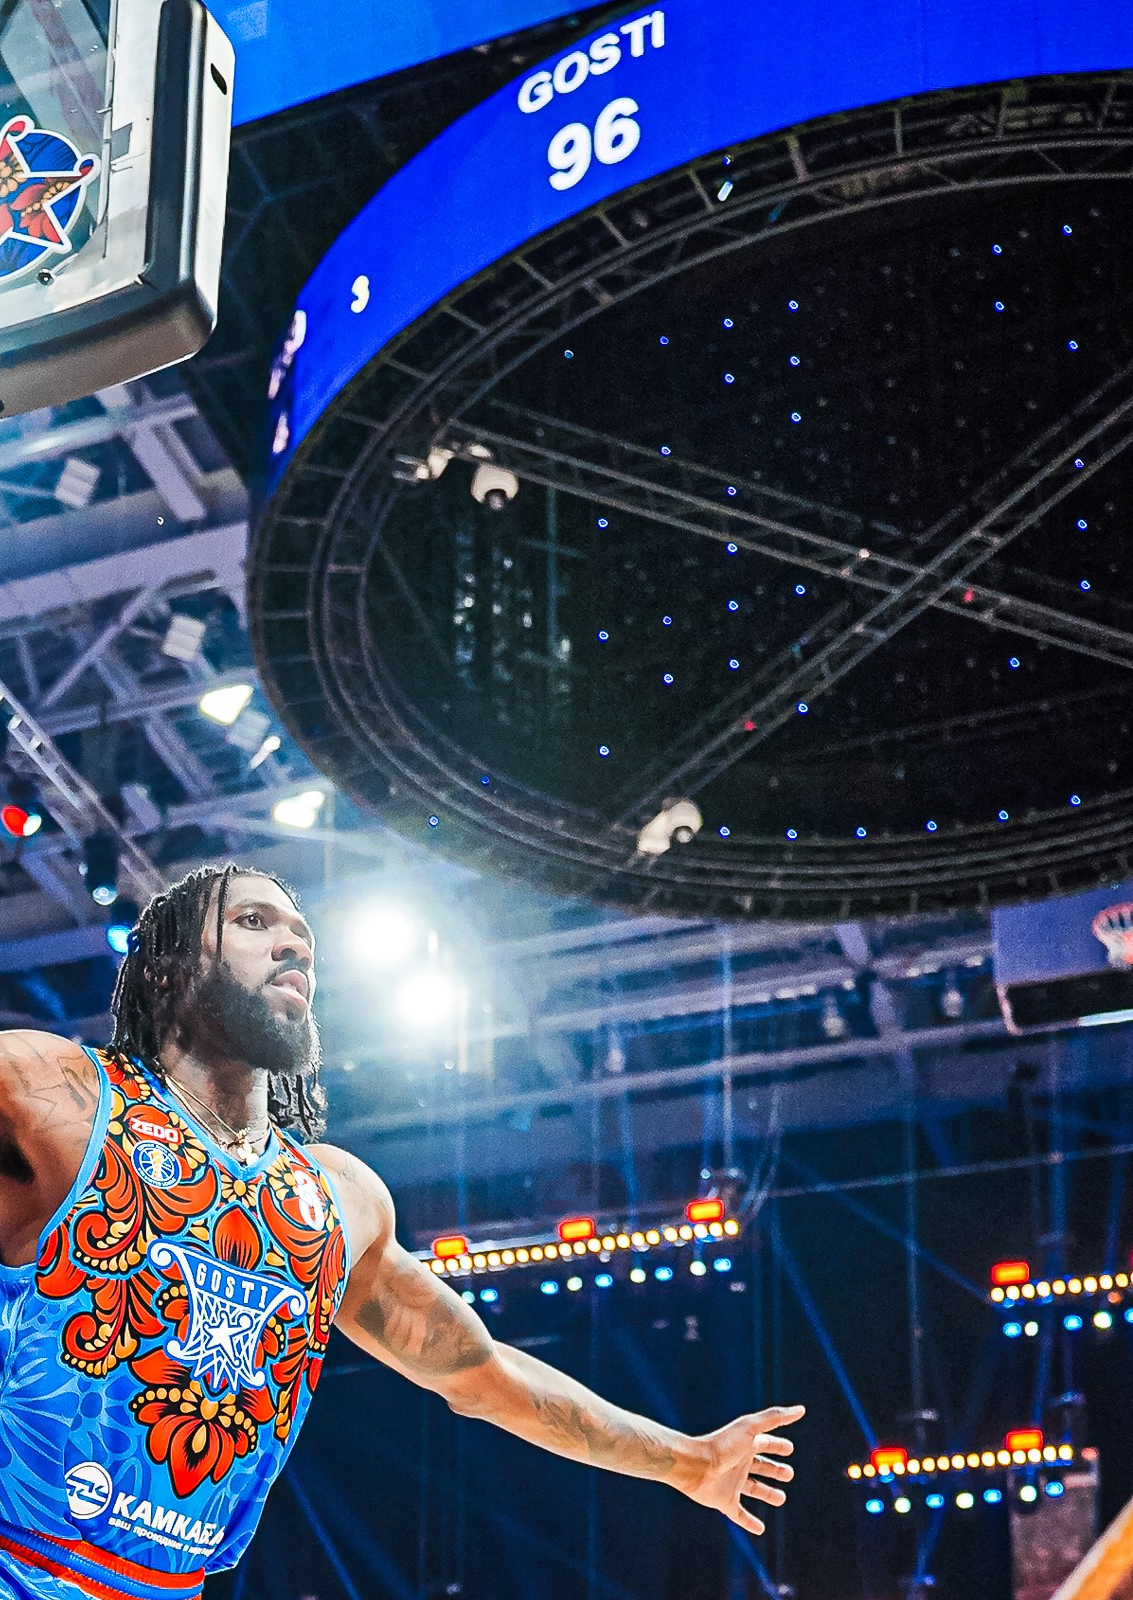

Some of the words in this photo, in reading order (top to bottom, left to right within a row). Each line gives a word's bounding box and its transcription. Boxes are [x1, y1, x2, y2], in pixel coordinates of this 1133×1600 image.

[518, 10, 665, 113] GOSTI
[547, 97, 641, 191] 96
[130, 1117, 179, 1143] ZEDO
[196, 1262, 268, 1309] GOSTI
